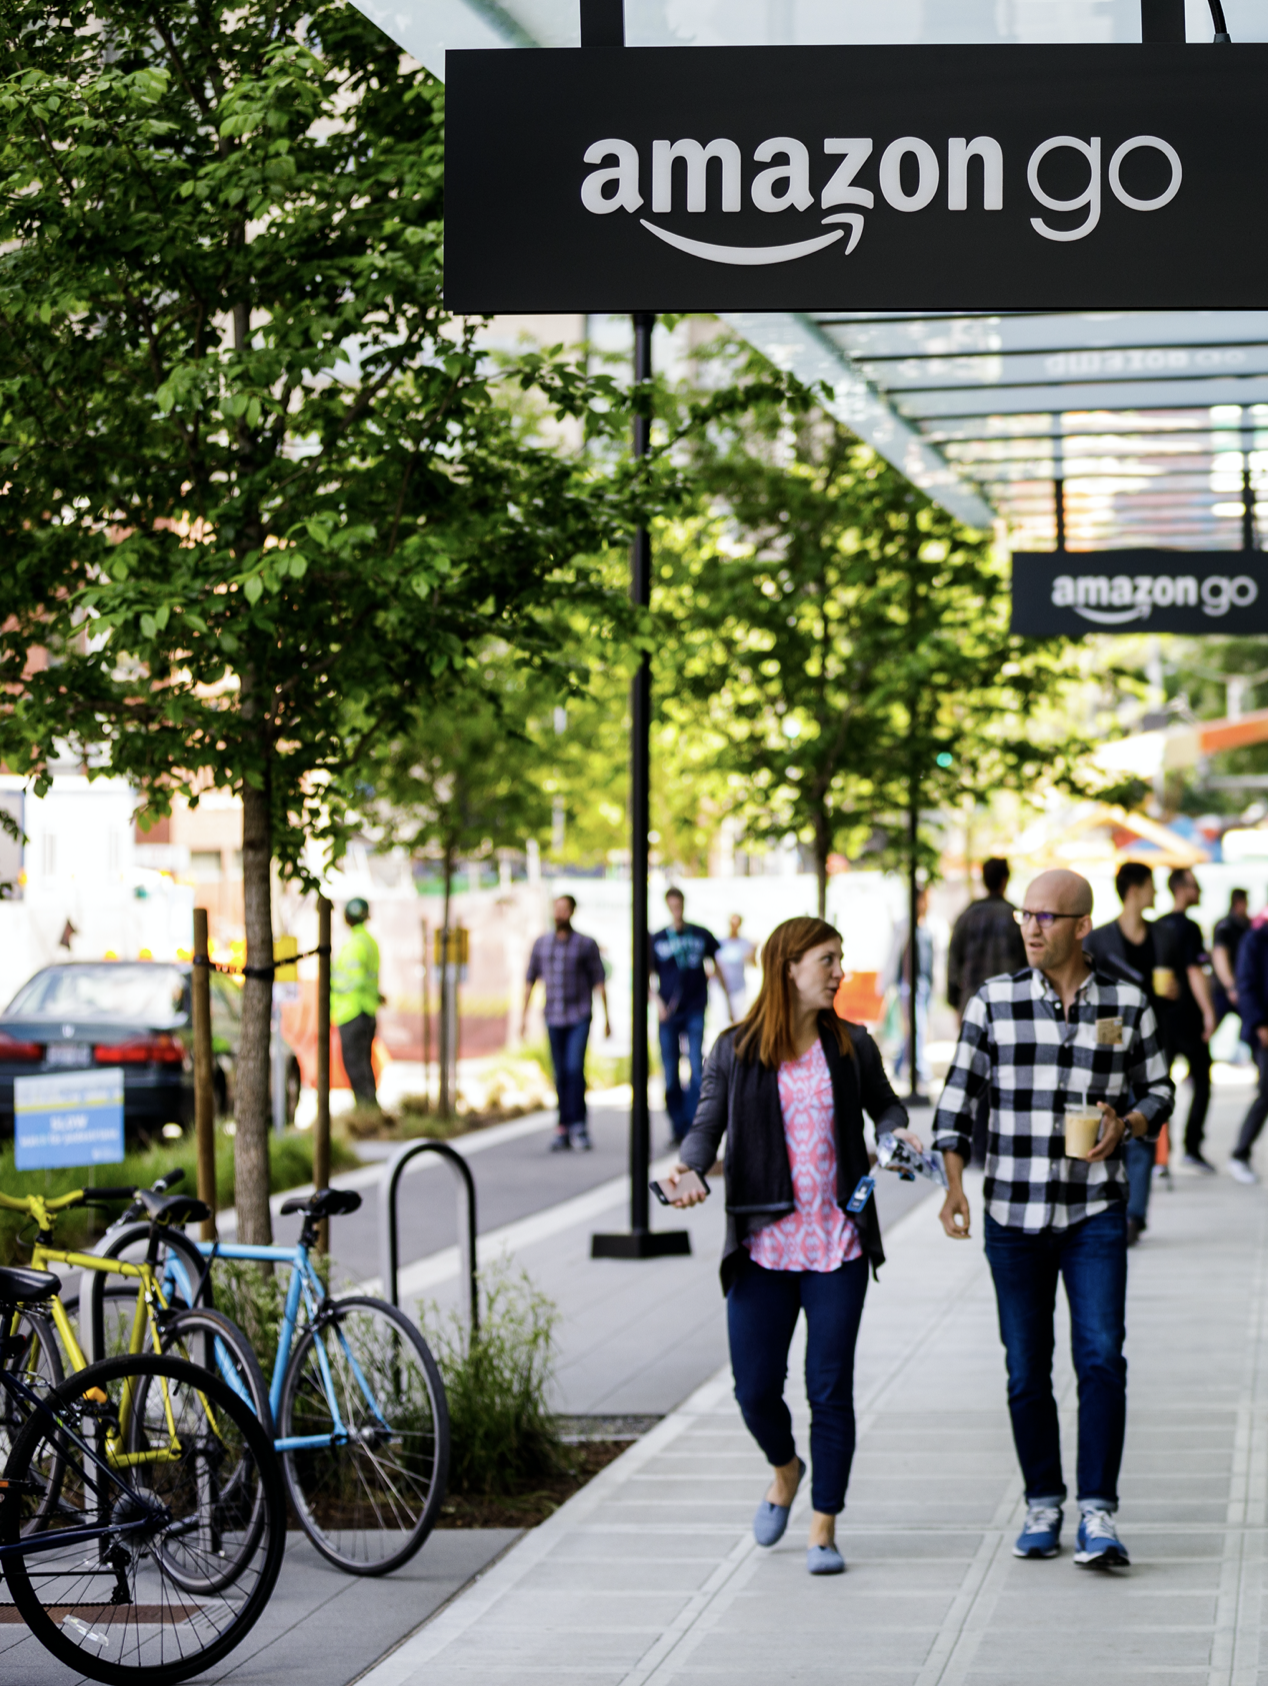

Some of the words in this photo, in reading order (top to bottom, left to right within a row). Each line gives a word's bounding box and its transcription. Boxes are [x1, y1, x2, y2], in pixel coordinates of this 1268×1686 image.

[580, 135, 1004, 216] amazon
[1026, 135, 1184, 242] go
[1050, 574, 1199, 609] amazon
[1200, 575, 1259, 617] go
